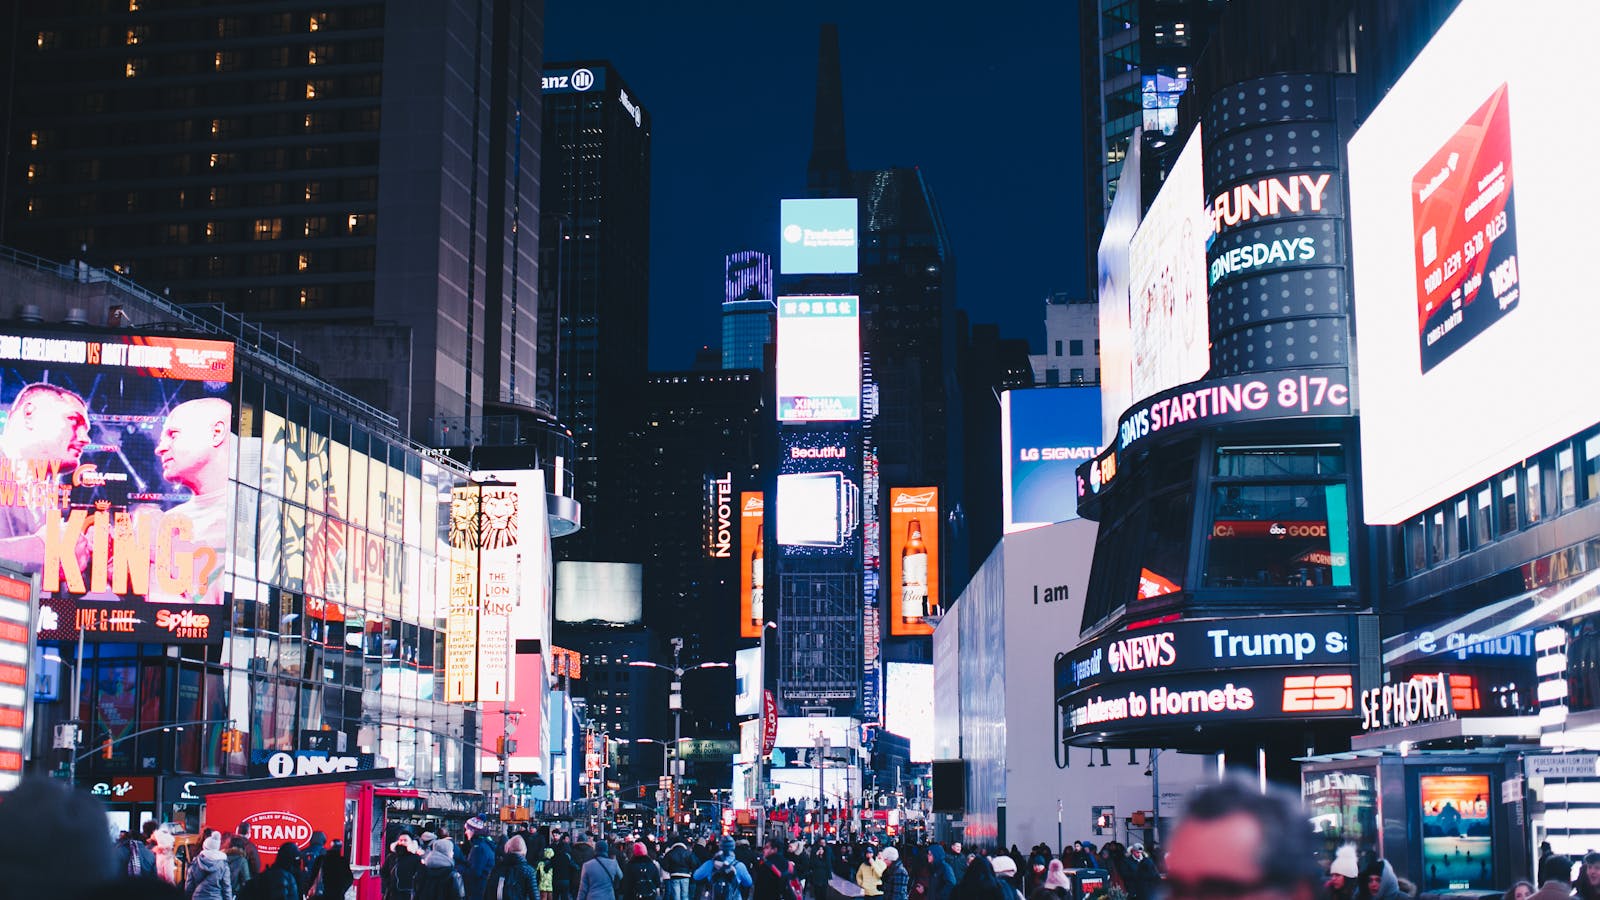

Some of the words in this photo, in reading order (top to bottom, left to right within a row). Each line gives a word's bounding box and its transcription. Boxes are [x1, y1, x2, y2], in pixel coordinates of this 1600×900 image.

[1214, 174, 1331, 234] FUNNY
[1444, 250, 1462, 282] 1234
[1464, 231, 1484, 264] 5678
[1485, 211, 1507, 243] 9123
[1489, 256, 1518, 299] VISA
[87, 342, 100, 364] VS
[794, 398, 842, 410] XINHUA
[1150, 382, 1269, 432] STARTING
[790, 446, 846, 459] Beautiful
[1020, 448, 1039, 461] LG
[0, 482, 71, 509] WEIGHT
[379, 490, 402, 524] THE
[716, 472, 732, 558] NOVOTEL
[1288, 525, 1327, 537] GOOD
[1310, 553, 1346, 567] MORNING
[489, 573, 506, 581] THE
[485, 584, 510, 597] LION
[1034, 585, 1038, 605] I
[1044, 585, 1069, 603] am
[484, 599, 513, 616] KING
[75, 608, 98, 631] LIVE
[99, 609, 108, 632] &
[110, 610, 135, 632] FREE
[155, 610, 210, 632] Spike
[176, 627, 208, 639] SPORTS
[1117, 632, 1176, 672] NEWS
[1207, 630, 1316, 661] Trump
[1128, 691, 1147, 717] to
[1150, 683, 1254, 716] Hornets
[1282, 674, 1353, 712] ES
[1361, 672, 1449, 730] SEPHORA
[297, 755, 359, 776] NYC
[246, 825, 309, 840] TRAND
